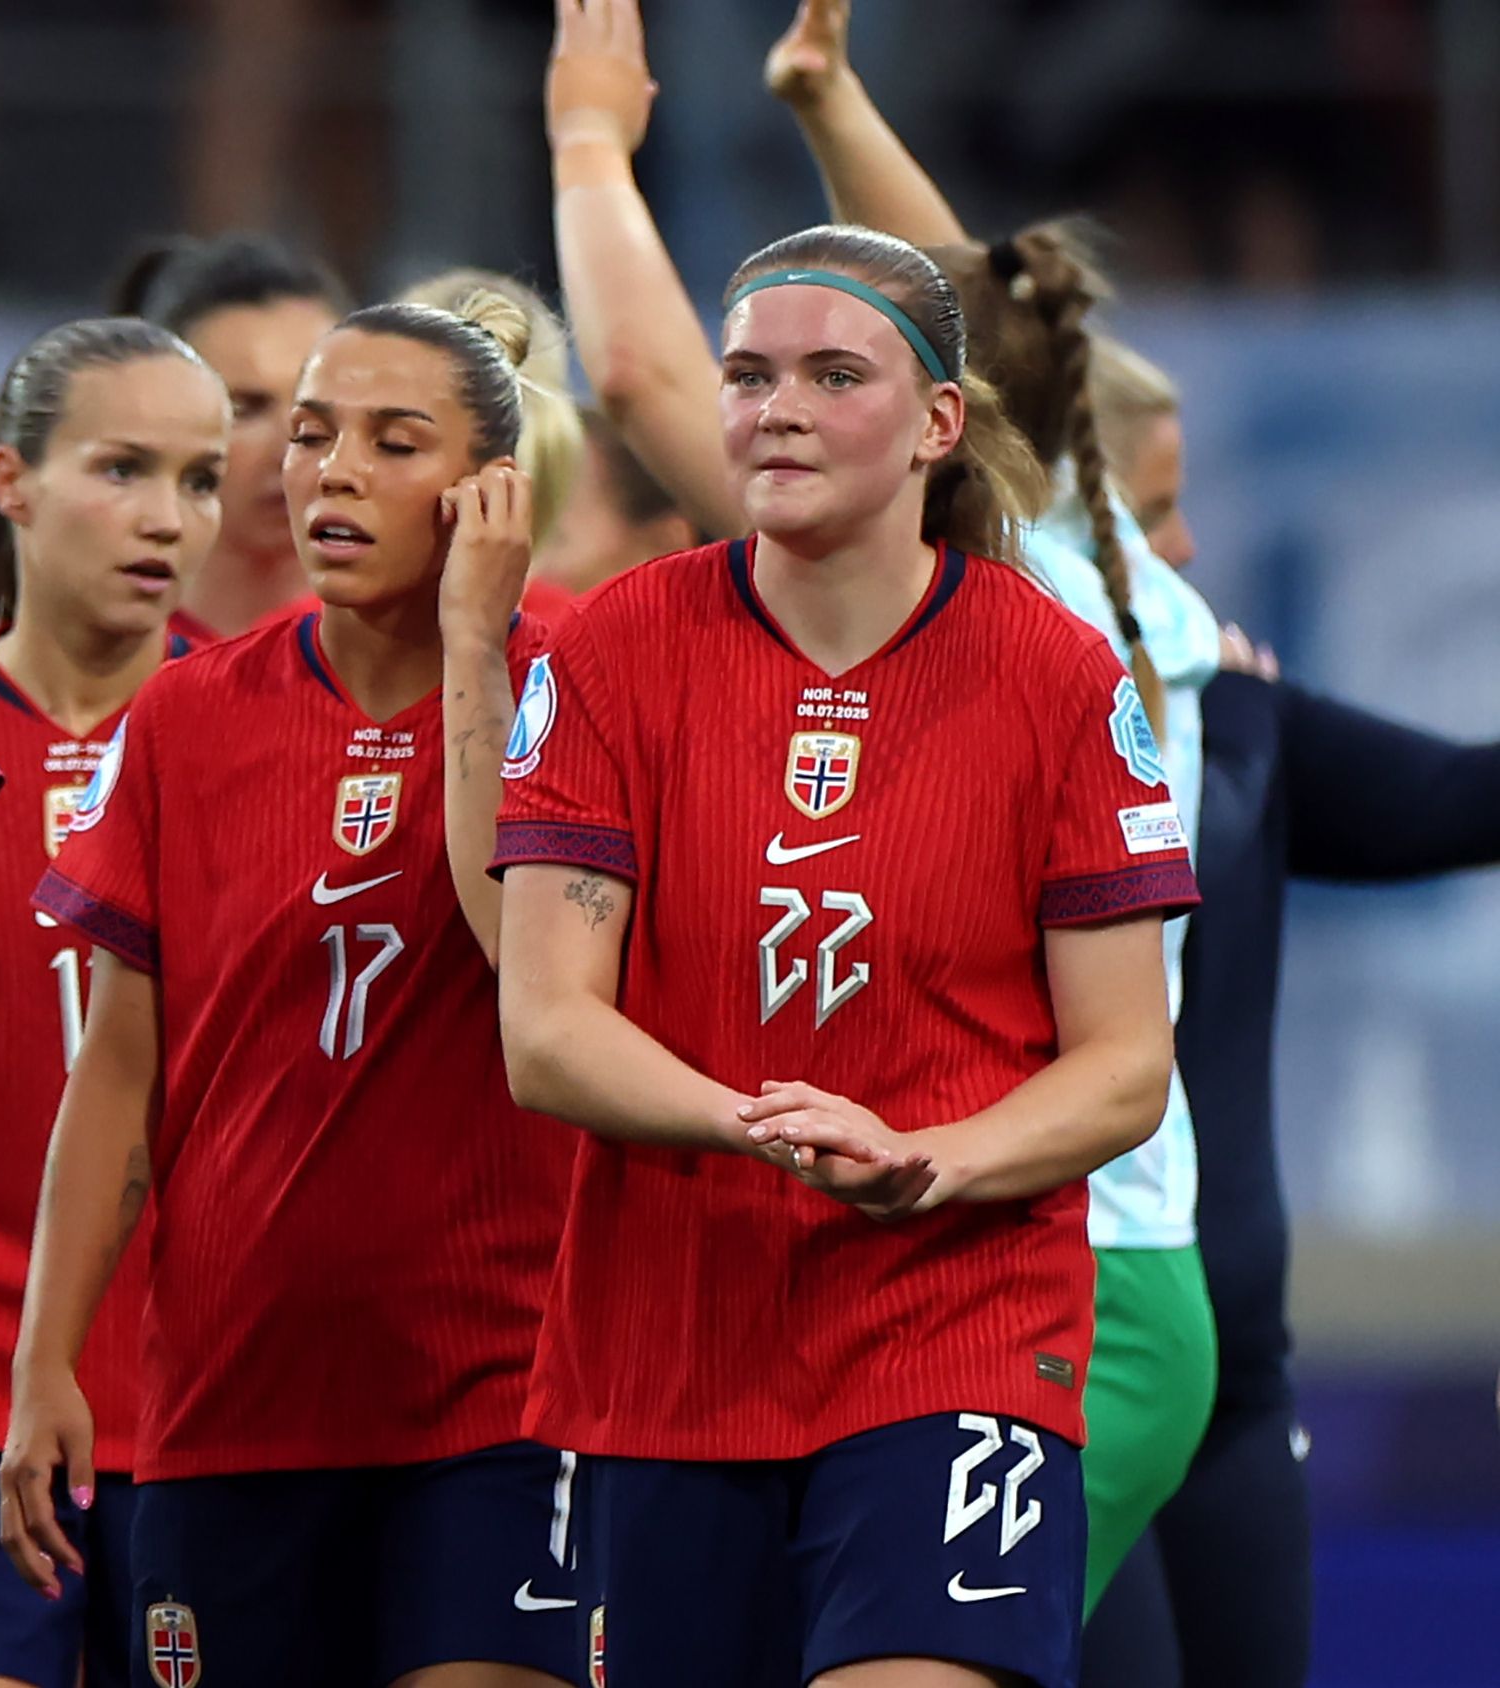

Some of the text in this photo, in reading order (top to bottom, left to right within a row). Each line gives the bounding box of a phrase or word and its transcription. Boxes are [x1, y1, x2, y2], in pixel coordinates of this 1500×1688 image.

[346, 744, 416, 759] 06.07.2025
[353, 727, 382, 742] NOR
[391, 732, 414, 744] FIN
[802, 687, 833, 702] NOR
[843, 690, 867, 704] FIN
[48, 947, 94, 1074] 1
[319, 923, 405, 1061] 17
[758, 887, 874, 1032] 22
[943, 1413, 1046, 1557] 22
